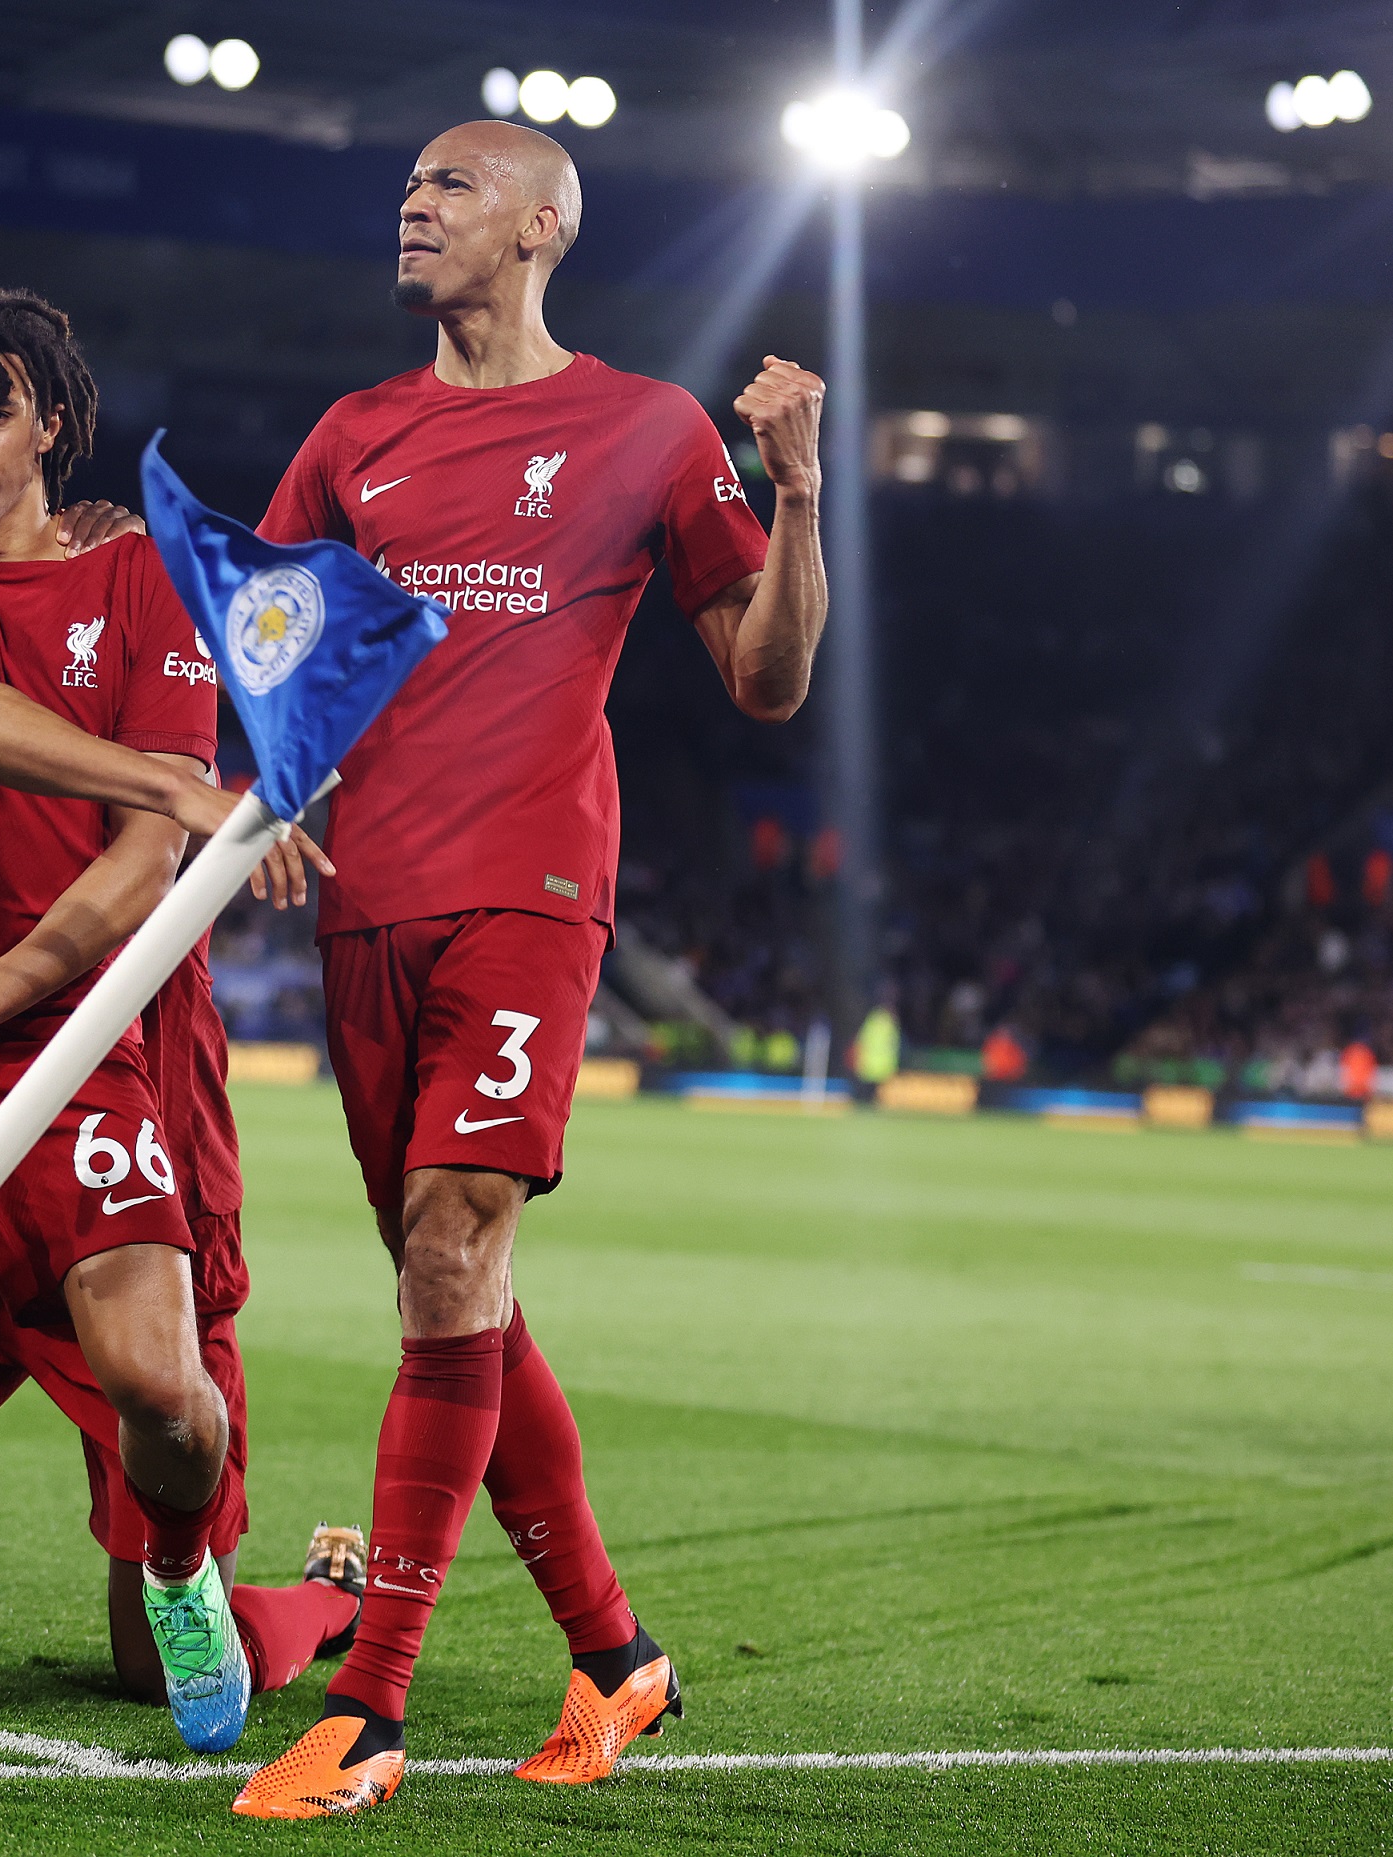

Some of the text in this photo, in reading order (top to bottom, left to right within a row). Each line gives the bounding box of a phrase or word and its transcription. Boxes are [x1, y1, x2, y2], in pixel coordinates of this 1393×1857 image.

[514, 501, 553, 518] L.F.C.
[400, 559, 543, 589] standard
[408, 585, 549, 614] hartered
[62, 670, 99, 689] L.F.C.
[474, 1010, 541, 1100] 3
[73, 1112, 176, 1195] 66
